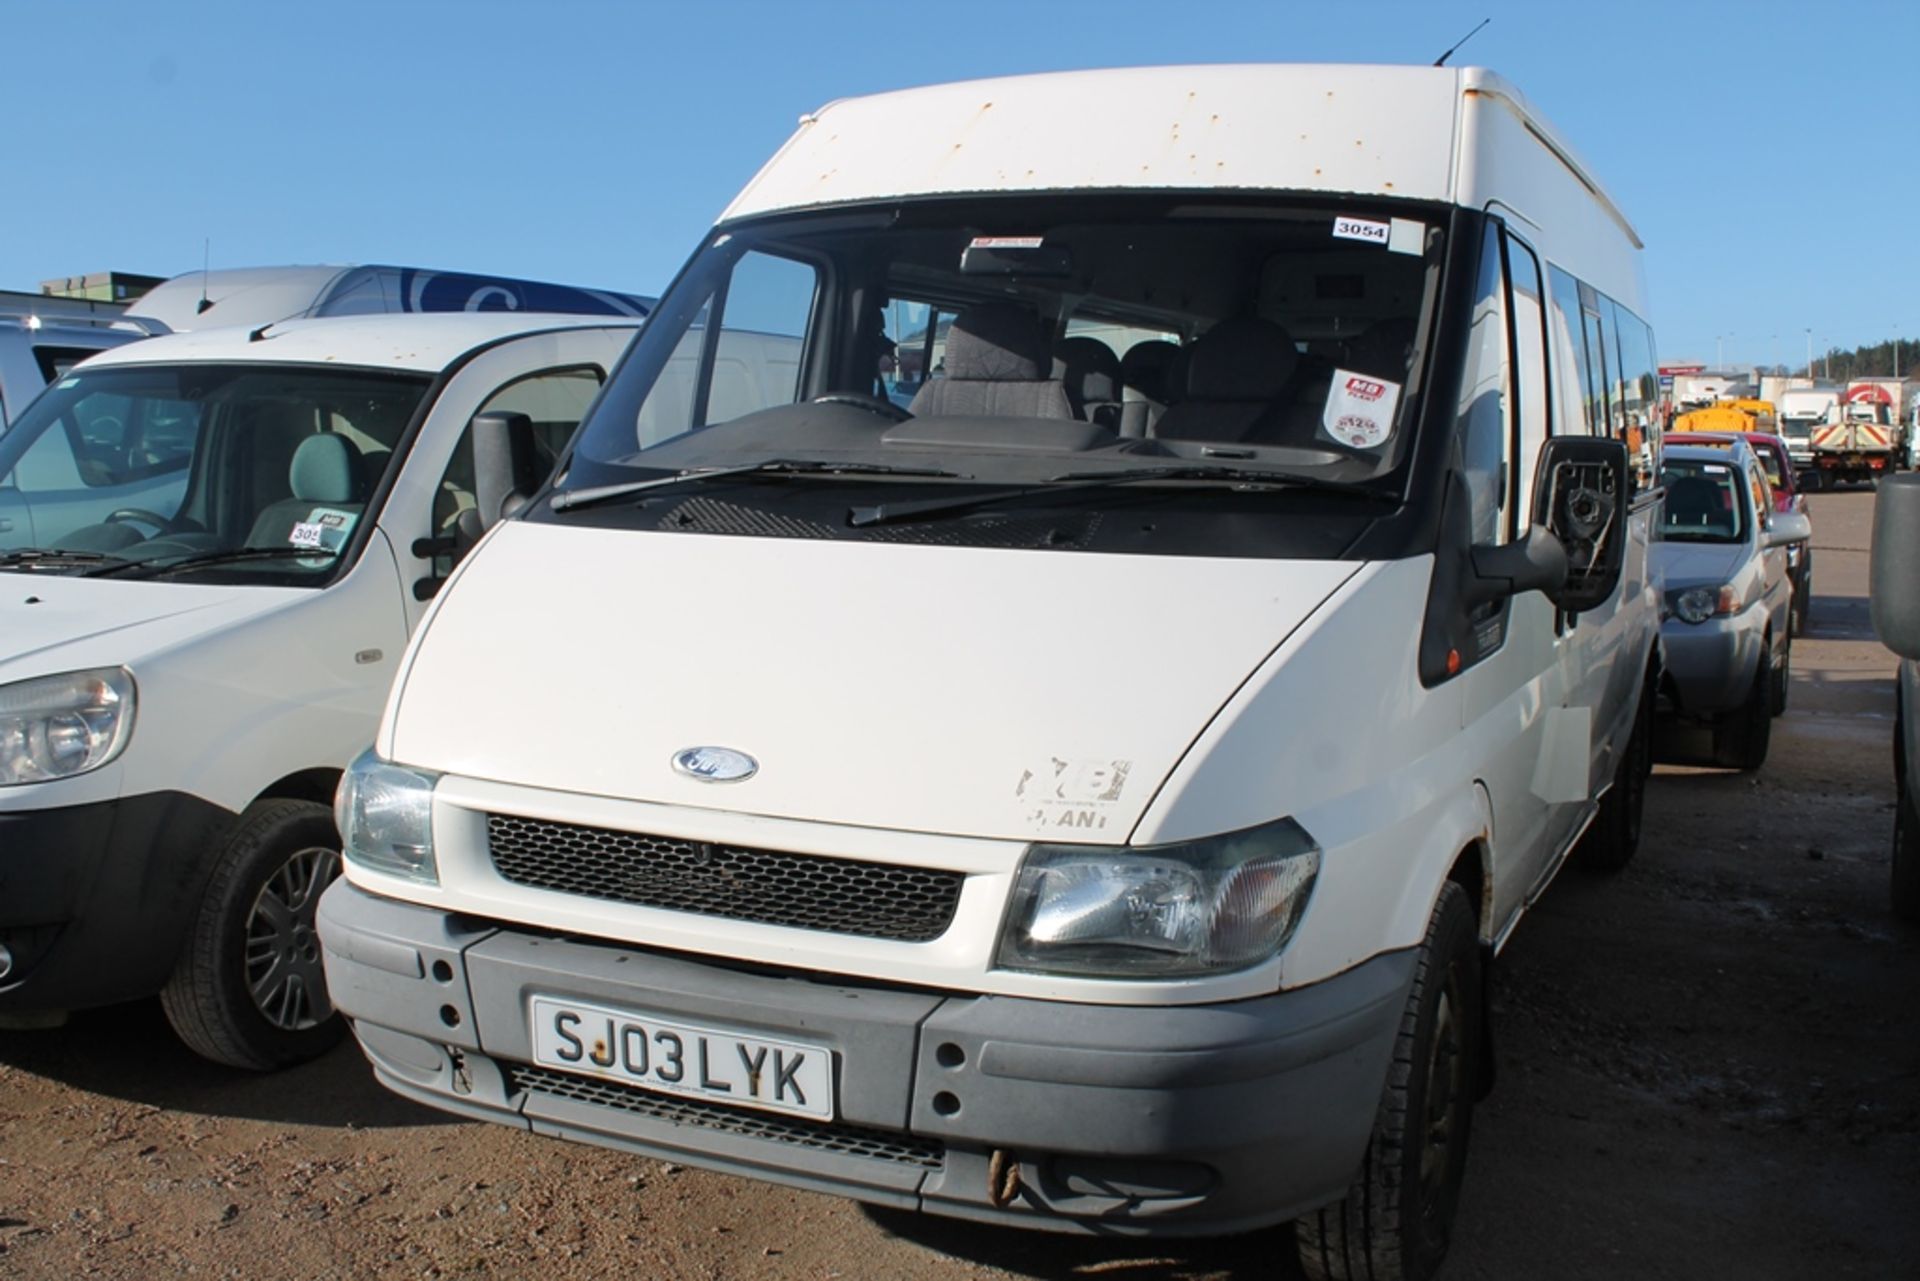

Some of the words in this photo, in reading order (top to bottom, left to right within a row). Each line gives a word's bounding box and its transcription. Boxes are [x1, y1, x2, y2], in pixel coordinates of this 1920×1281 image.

[1338, 222, 1385, 238] 3054
[554, 1010, 684, 1083] SJ03
[698, 1037, 807, 1106] LYK
